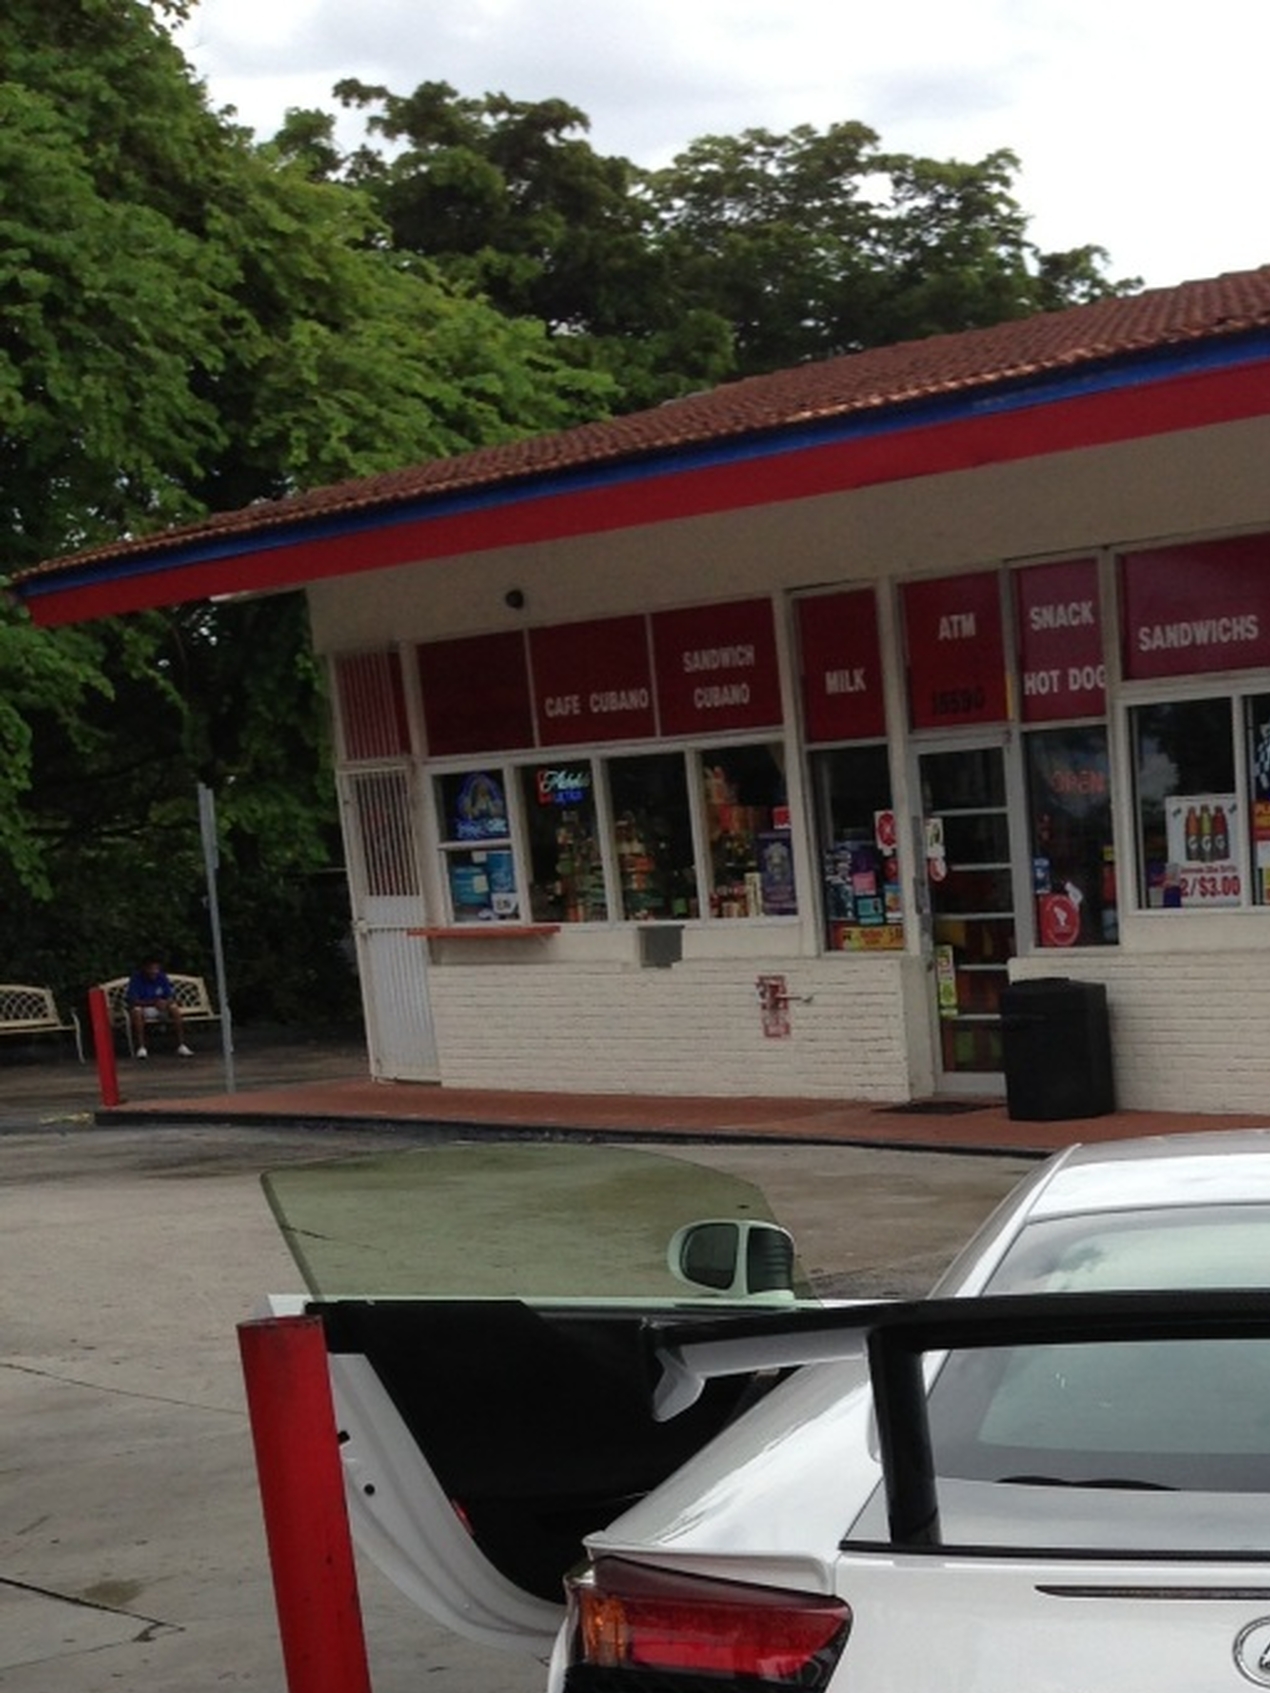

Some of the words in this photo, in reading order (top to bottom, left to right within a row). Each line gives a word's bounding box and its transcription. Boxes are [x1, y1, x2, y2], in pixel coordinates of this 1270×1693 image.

[938, 612, 977, 642] ATM
[1030, 601, 1095, 631] SNACK
[1138, 614, 1260, 652] SANDWICHS
[683, 645, 756, 673] SANDWICH
[825, 669, 867, 693] MILK
[1023, 669, 1060, 697] HOT
[545, 695, 582, 718] CAFE
[589, 689, 650, 714] CUBANO
[693, 684, 750, 709] CUBANO
[1179, 875, 1241, 899] 2/$3.00
